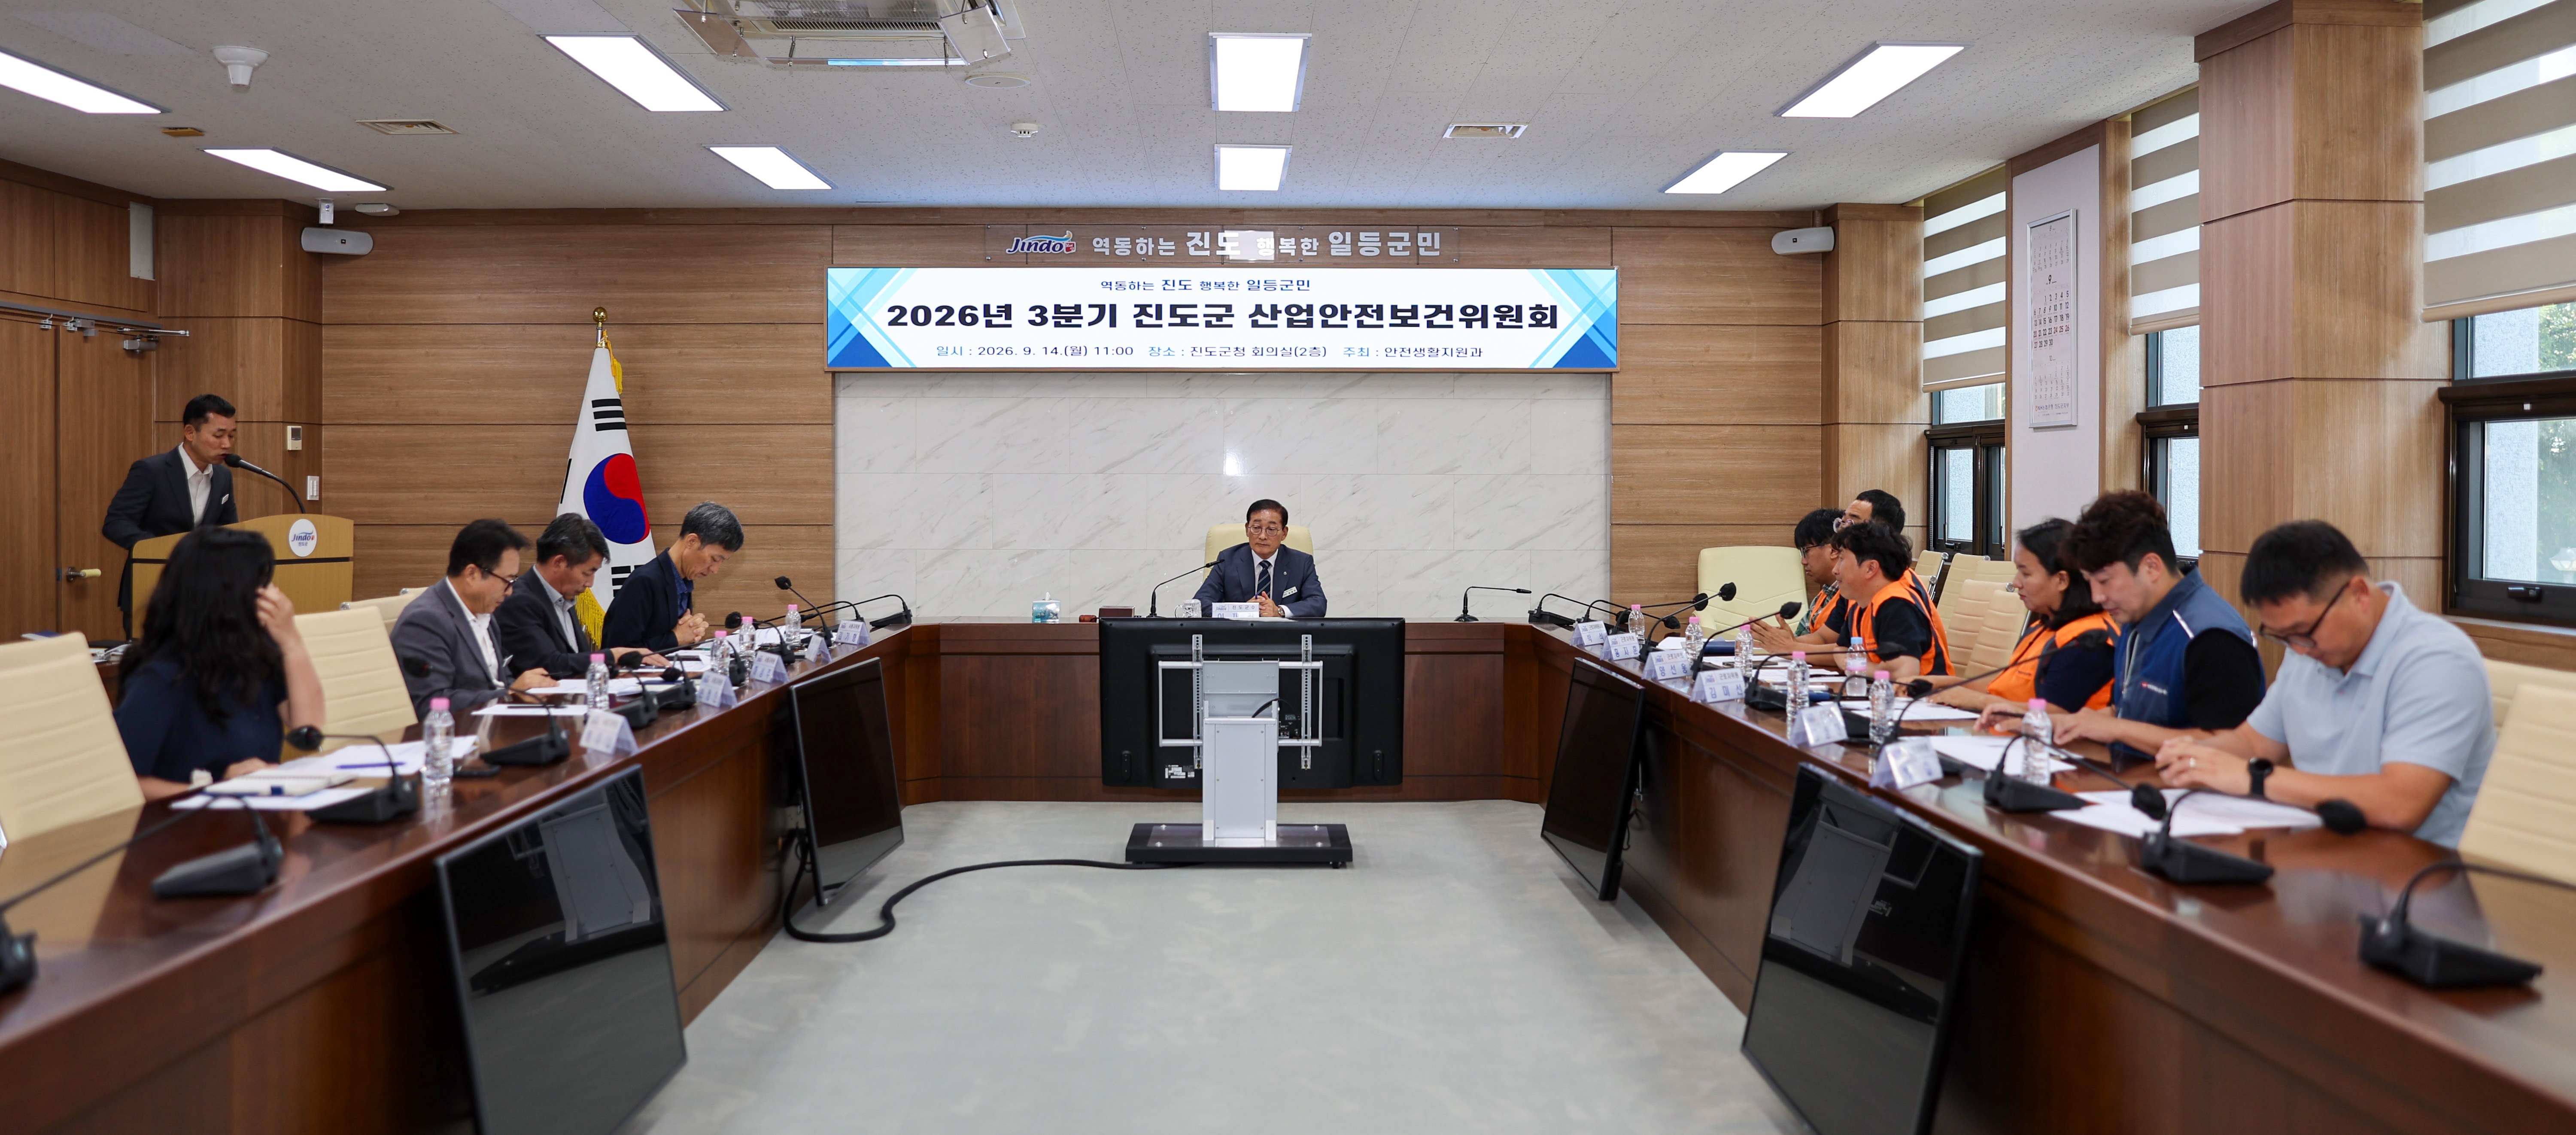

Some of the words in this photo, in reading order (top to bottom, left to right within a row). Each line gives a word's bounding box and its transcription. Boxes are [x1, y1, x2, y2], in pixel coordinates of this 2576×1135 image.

[1006, 237, 1064, 253] Jindo
[1092, 237, 1176, 256] 역동하는
[1186, 231, 1241, 256] 진도
[1257, 237, 1319, 256] 행복한
[1328, 231, 1440, 256] 일등군민
[1100, 280, 1154, 291] 역동하는
[1161, 279, 1193, 291] 진도
[1200, 280, 1240, 291] 행복한
[1246, 279, 1310, 291] 일등군민
[2048, 275, 2051, 284] 9
[887, 303, 1013, 328] 2026년
[1028, 303, 1117, 328] 3분기
[1133, 303, 1235, 329] 진도군
[1248, 303, 1558, 329] 산업안전보건위원회
[936, 346, 963, 356] 일시
[978, 346, 1018, 355] 2026.
[1042, 345, 1088, 357] 14.(월)
[1094, 346, 1134, 355] 11:00
[1148, 346, 1176, 357] 장소
[1190, 346, 1245, 357] 진도군청
[1252, 346, 1327, 358] 회의실(2층)
[1343, 347, 1370, 358] 주최
[1384, 347, 1483, 358] 안전생활지원과
